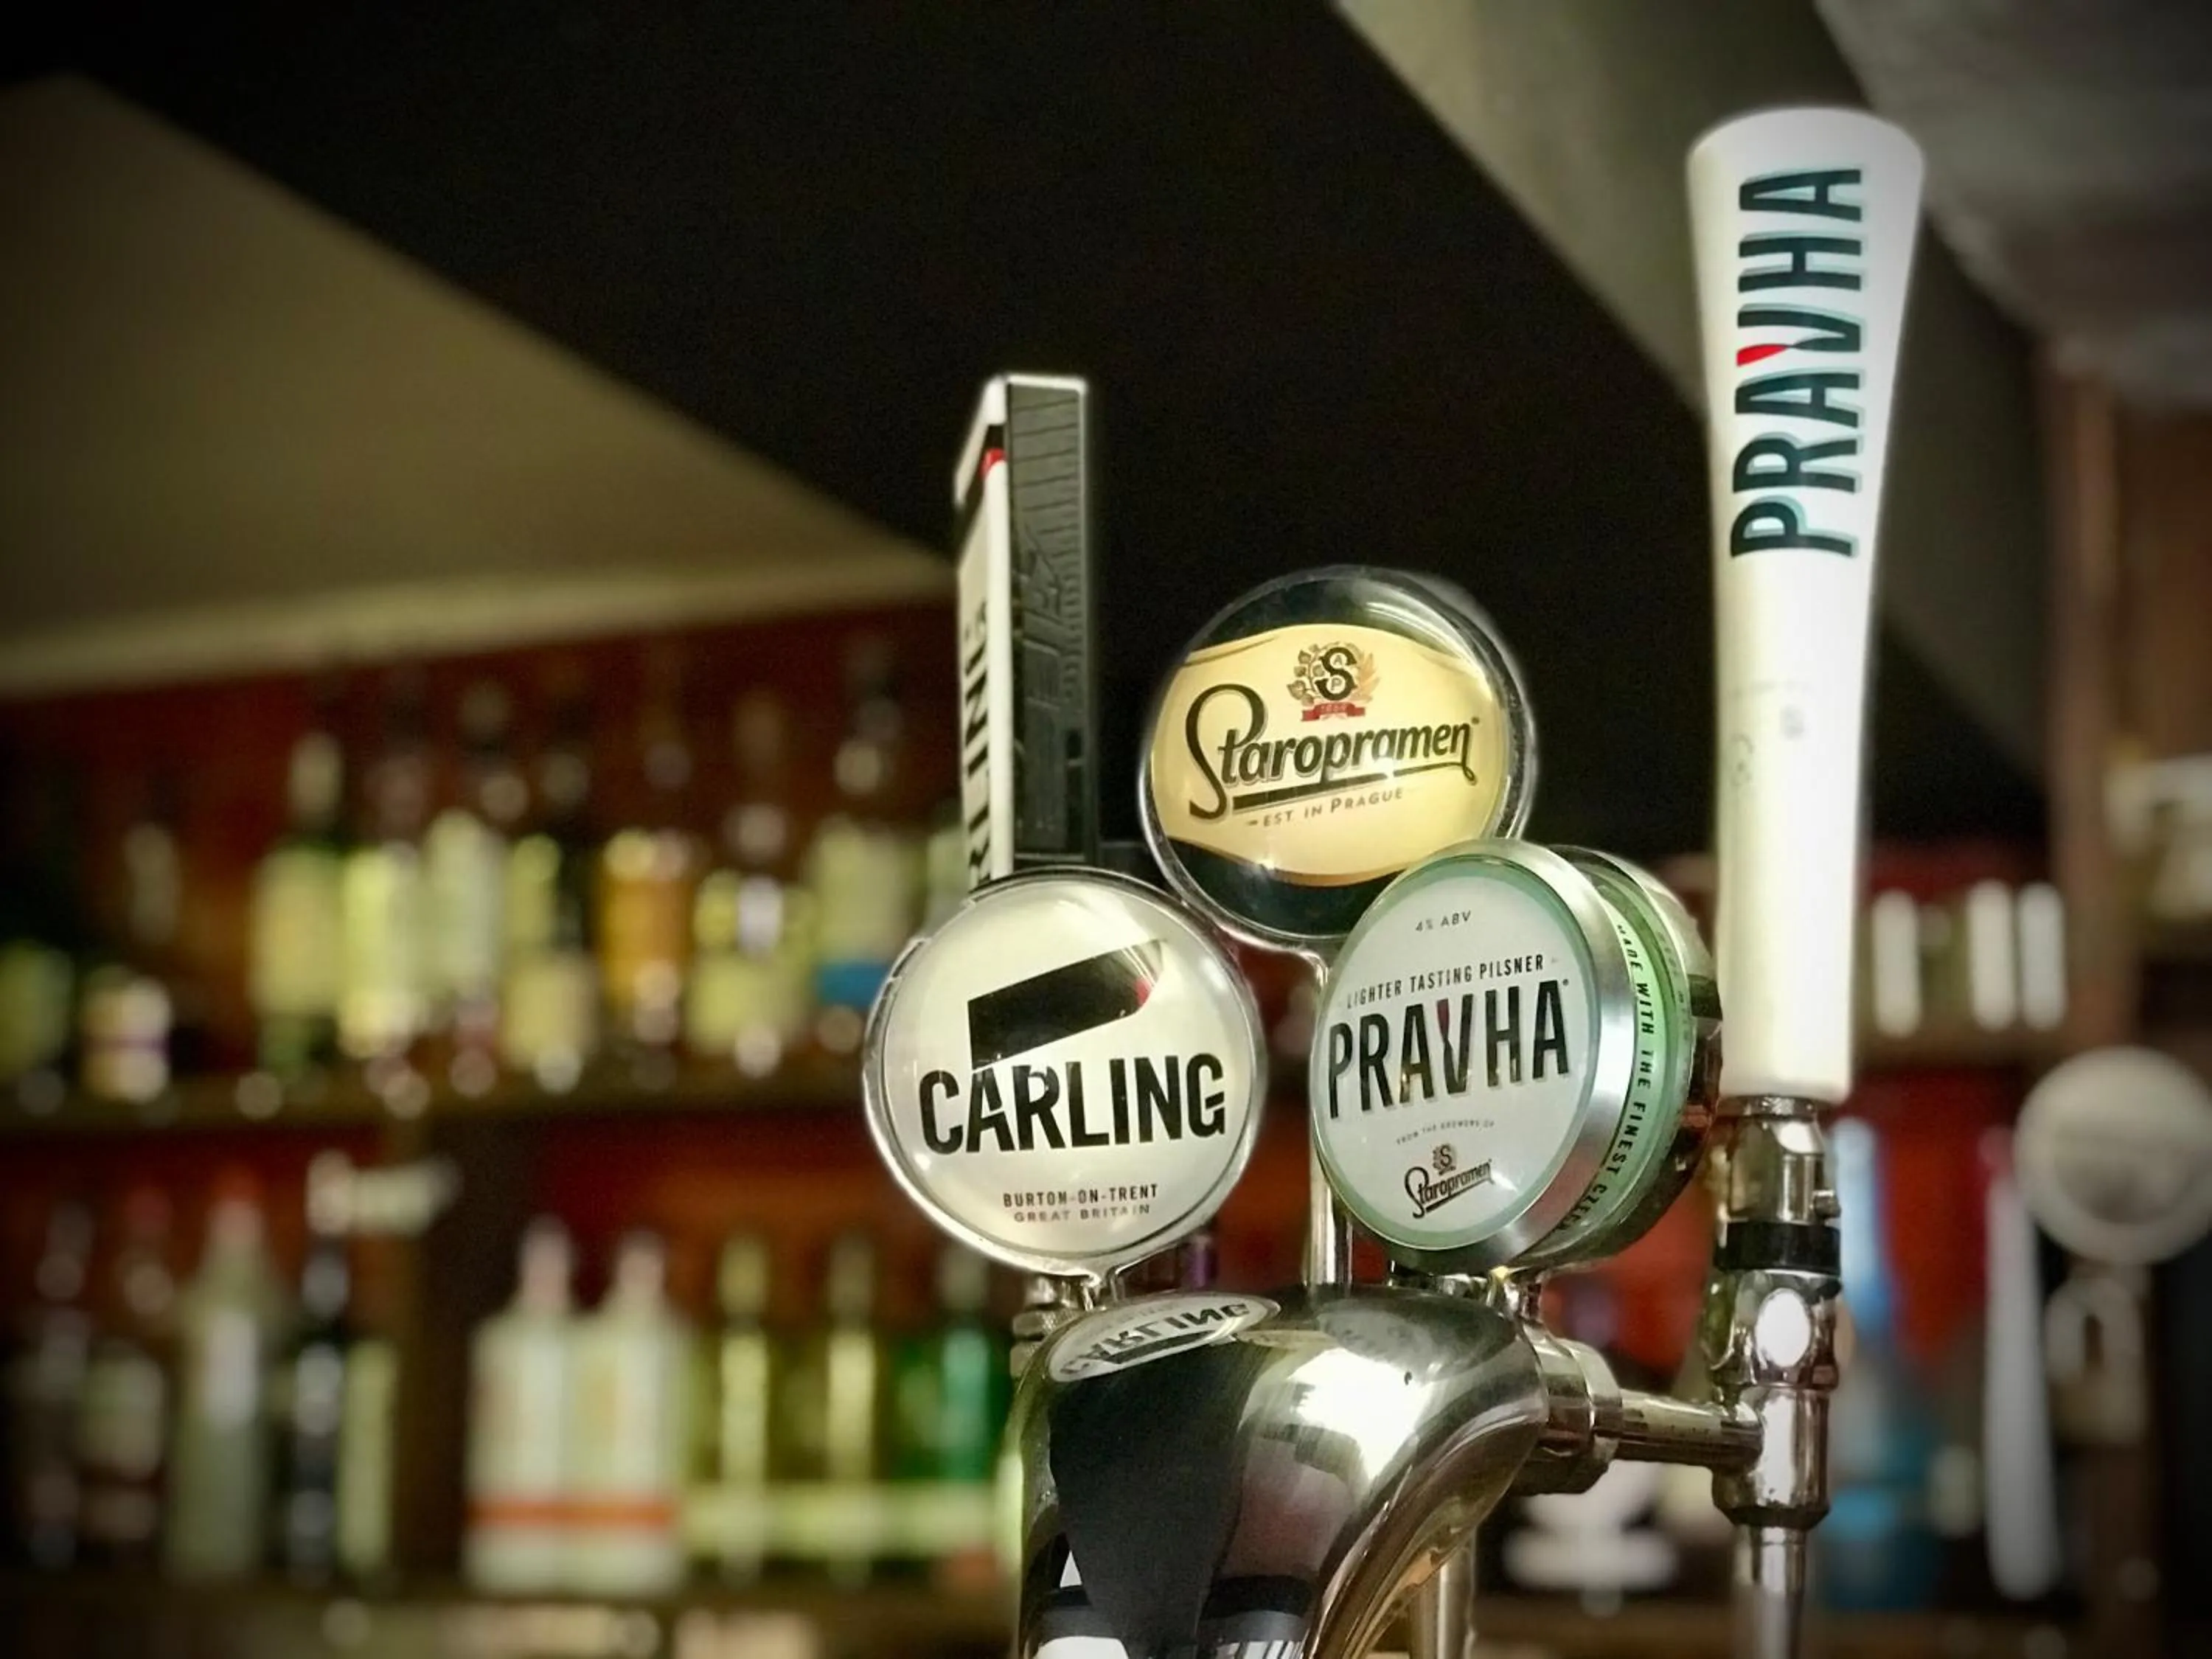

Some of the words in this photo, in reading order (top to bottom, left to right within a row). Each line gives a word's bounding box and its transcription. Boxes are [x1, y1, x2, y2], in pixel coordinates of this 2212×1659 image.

[1730, 169, 1863, 557] PRAVHA
[1185, 684, 1477, 820] Staropramen
[1263, 810, 1294, 827] EST
[1304, 805, 1323, 818] IN
[1330, 787, 1404, 813] PRAGUE
[1441, 911, 1472, 928] ABV
[1347, 979, 1402, 1009] LIGHTER
[1410, 965, 1472, 993] TASTING
[1479, 954, 1543, 979] PILSNER
[1636, 983, 1655, 1034] WITH
[1328, 980, 1569, 1119] PRAVHA
[1637, 1050, 1654, 1088] THE
[919, 1053, 1225, 1155] CARLING
[1606, 1101, 1646, 1175] FINEST
[1003, 1183, 1158, 1208] BURTON-ON-TRENT
[1014, 1210, 1071, 1223] GREAT
[1079, 1203, 1150, 1220] BRITAIN
[1404, 1161, 1495, 1219] Staropramen
